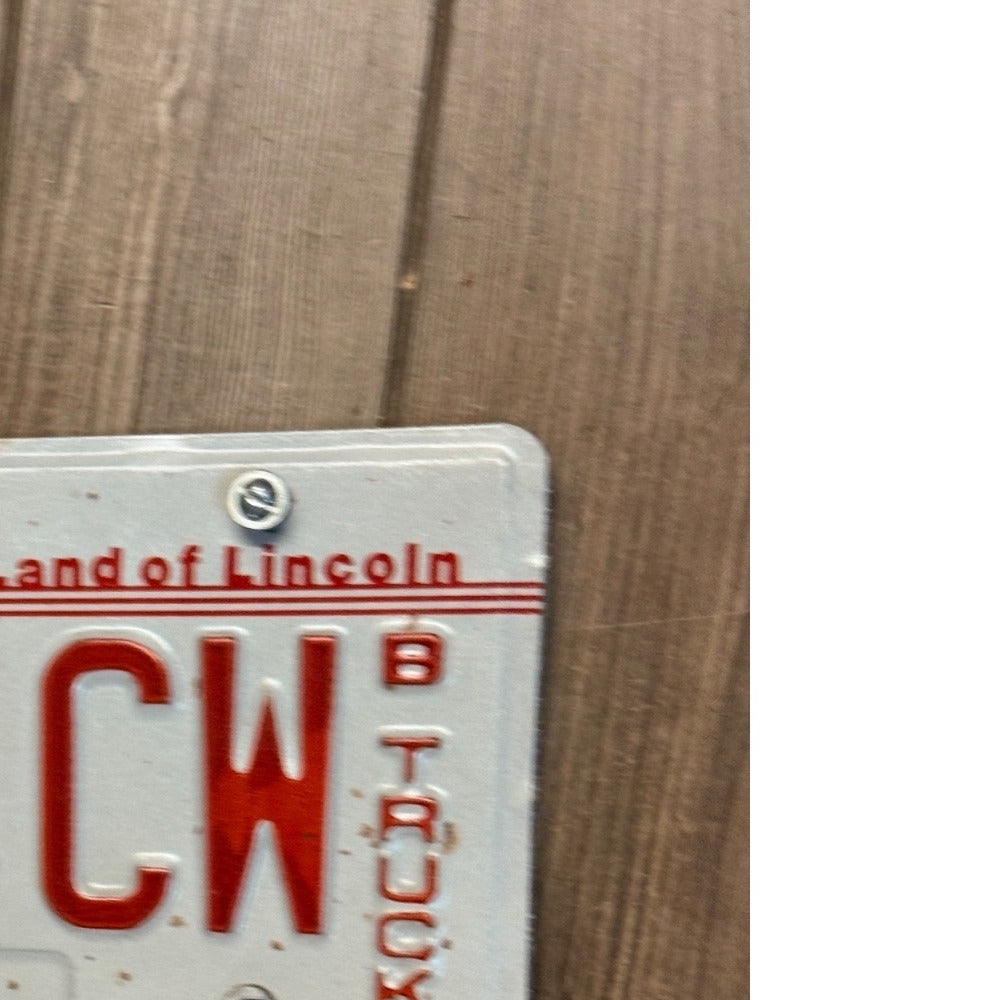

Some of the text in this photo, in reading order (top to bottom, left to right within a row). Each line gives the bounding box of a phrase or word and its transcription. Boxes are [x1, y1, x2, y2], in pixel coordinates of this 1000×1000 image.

[140, 546, 203, 587] of
[223, 543, 461, 586] Lincoln
[382, 632, 444, 685] B
[40, 635, 339, 934] CW
